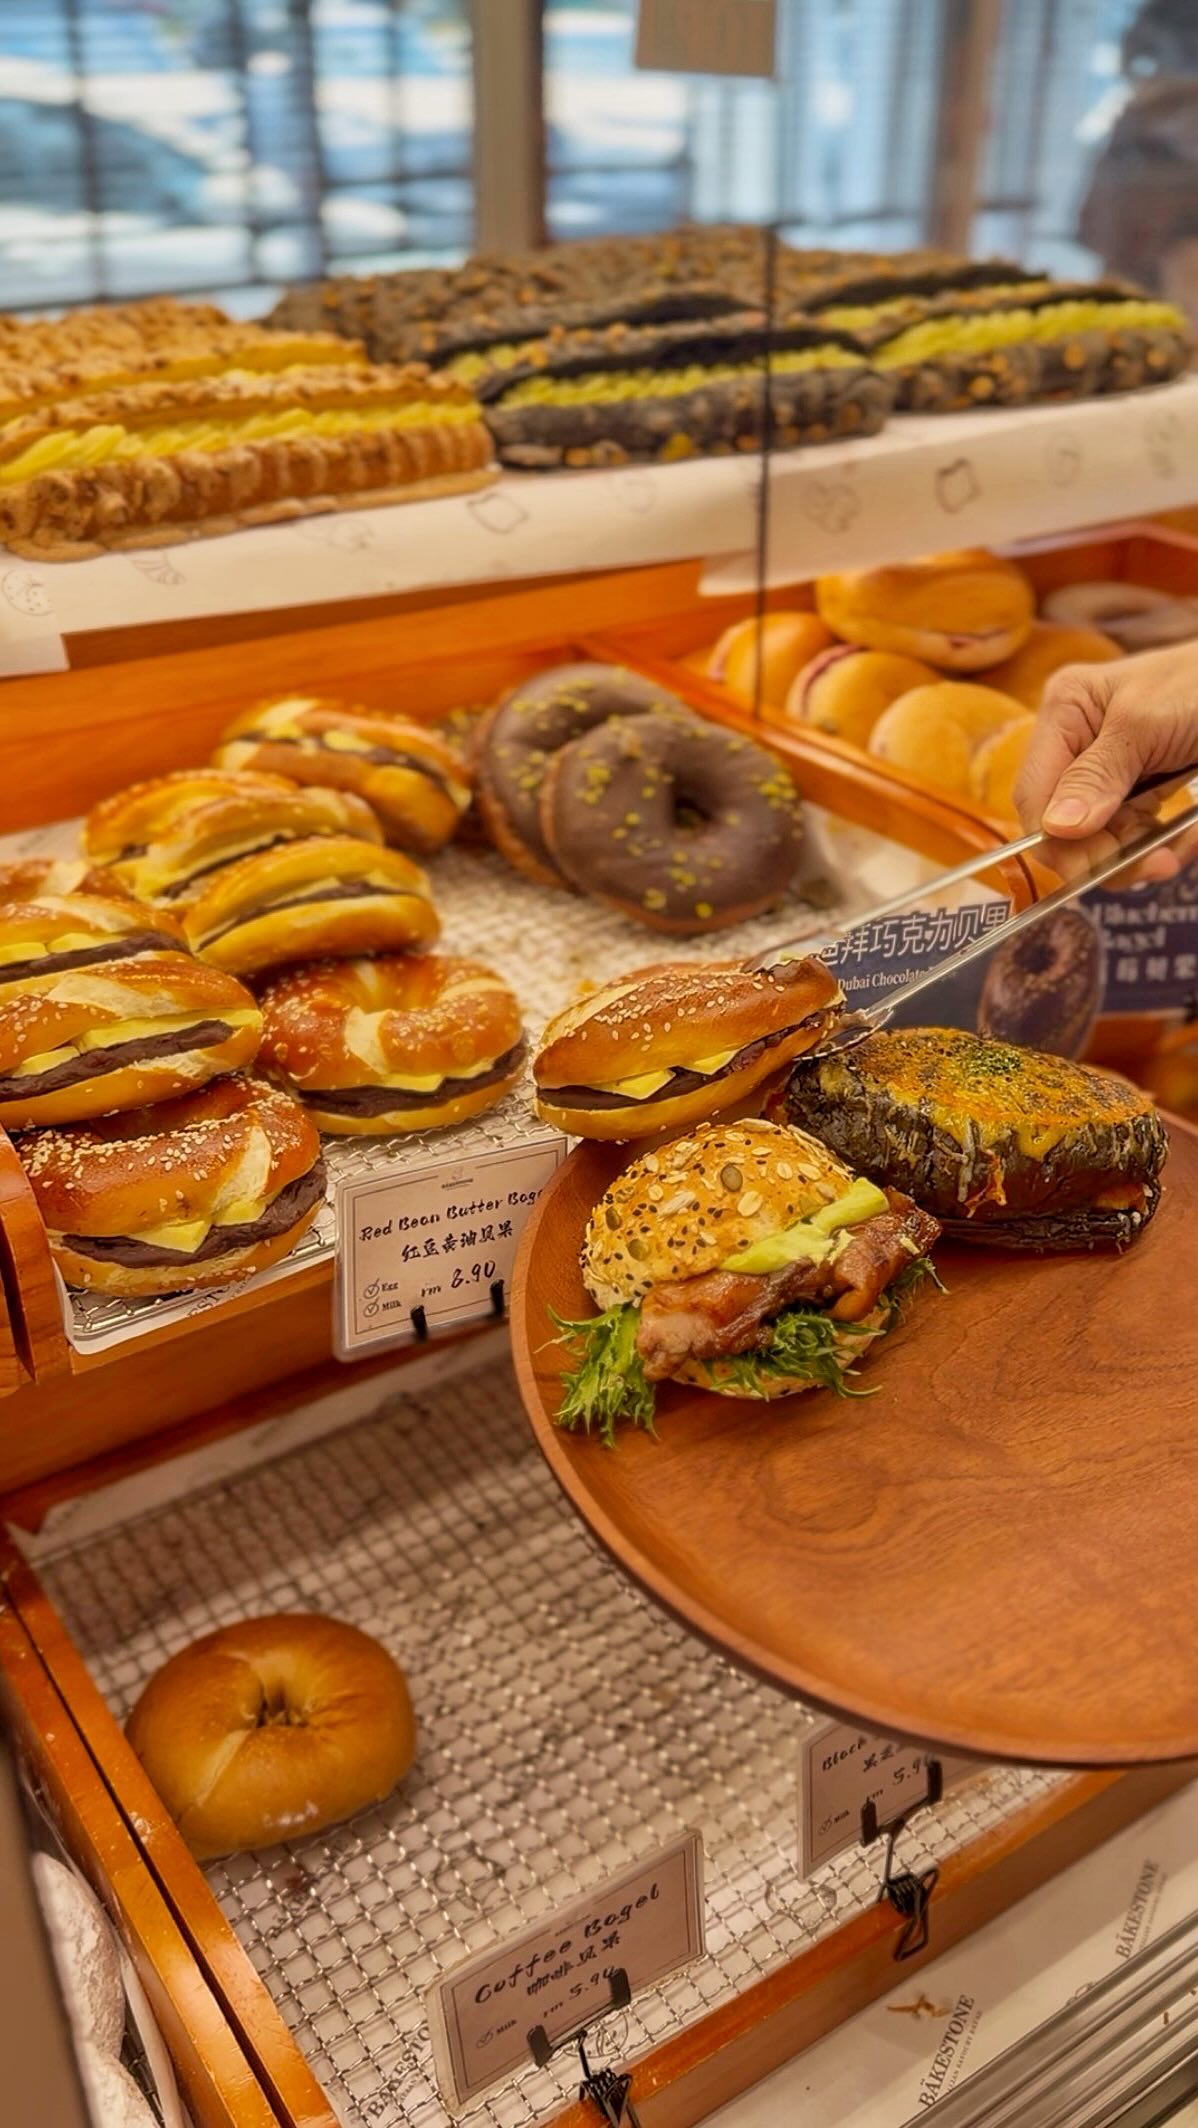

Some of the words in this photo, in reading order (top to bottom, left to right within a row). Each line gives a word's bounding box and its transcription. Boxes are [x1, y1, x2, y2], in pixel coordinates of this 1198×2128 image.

[838, 975, 871, 991] Dubai
[360, 1219, 393, 1241] Red
[446, 1198, 502, 1219] Butter
[508, 1189, 543, 1205] Bag
[401, 1220, 513, 1262] 红豆黄油贝果
[450, 1260, 496, 1288] 8.90
[474, 1941, 572, 2004] Coffee
[918, 1994, 976, 2107] BÄKESTONE
